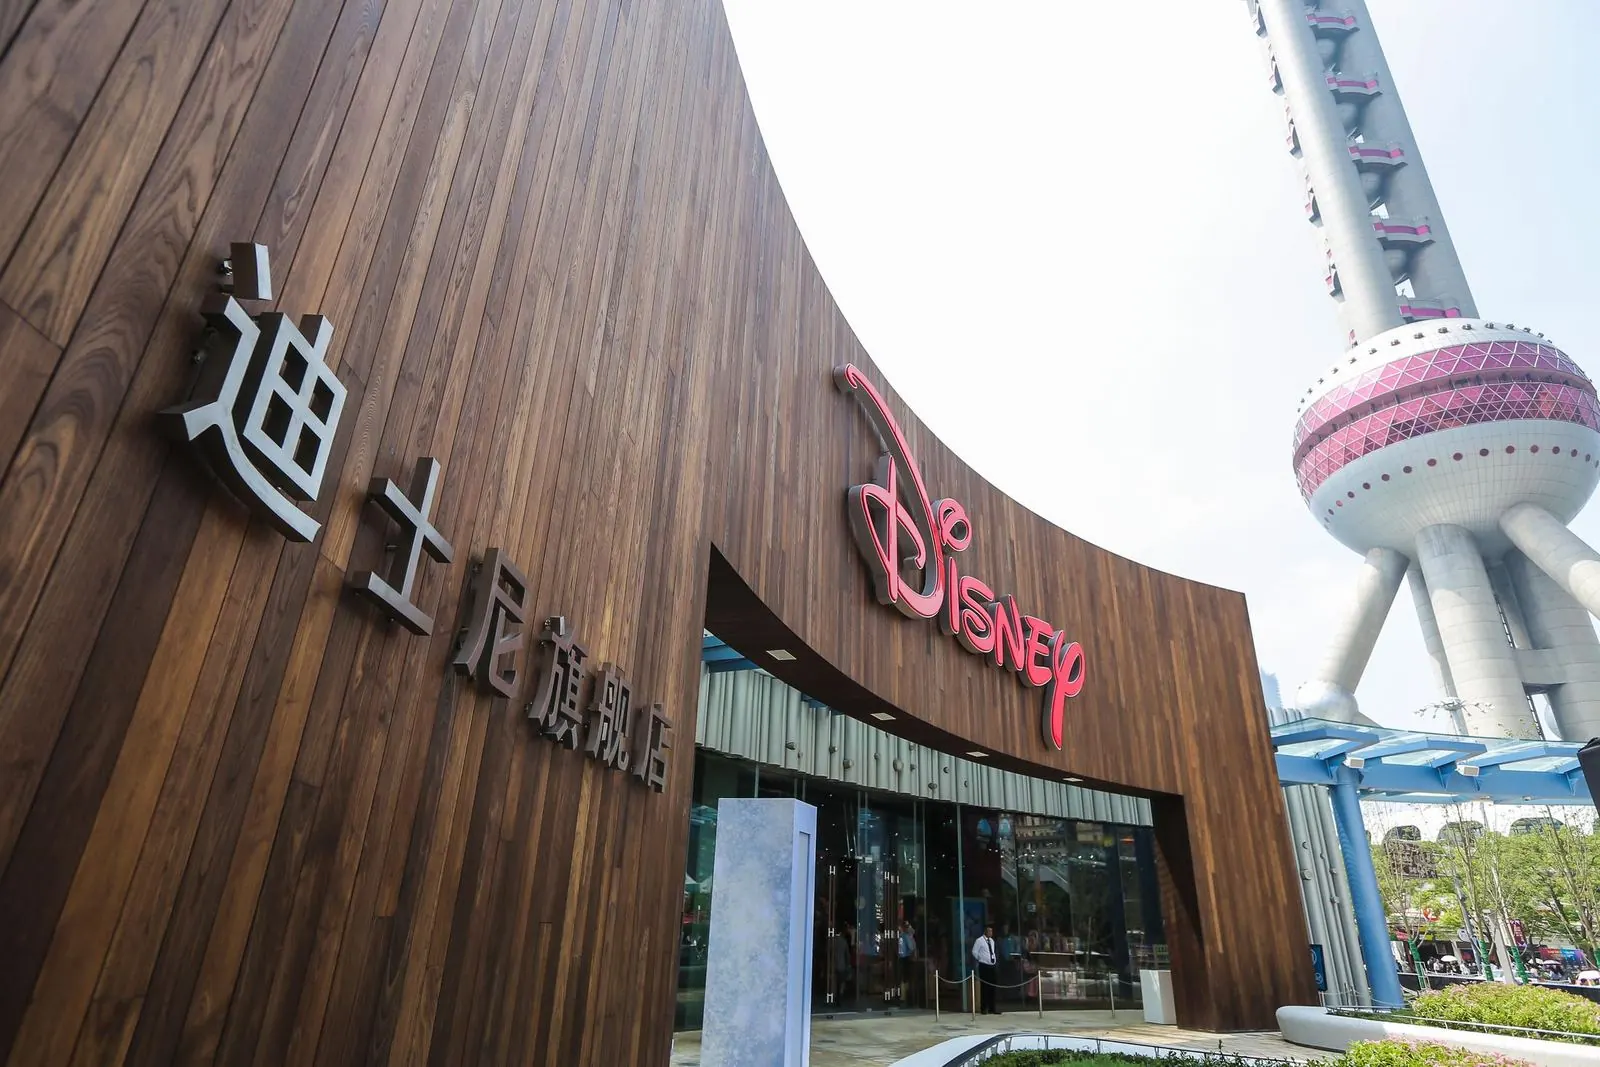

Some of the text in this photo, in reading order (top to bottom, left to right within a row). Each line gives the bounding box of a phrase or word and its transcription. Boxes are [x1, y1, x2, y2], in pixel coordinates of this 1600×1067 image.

[176, 242, 672, 793] 迪士尼旗舰店
